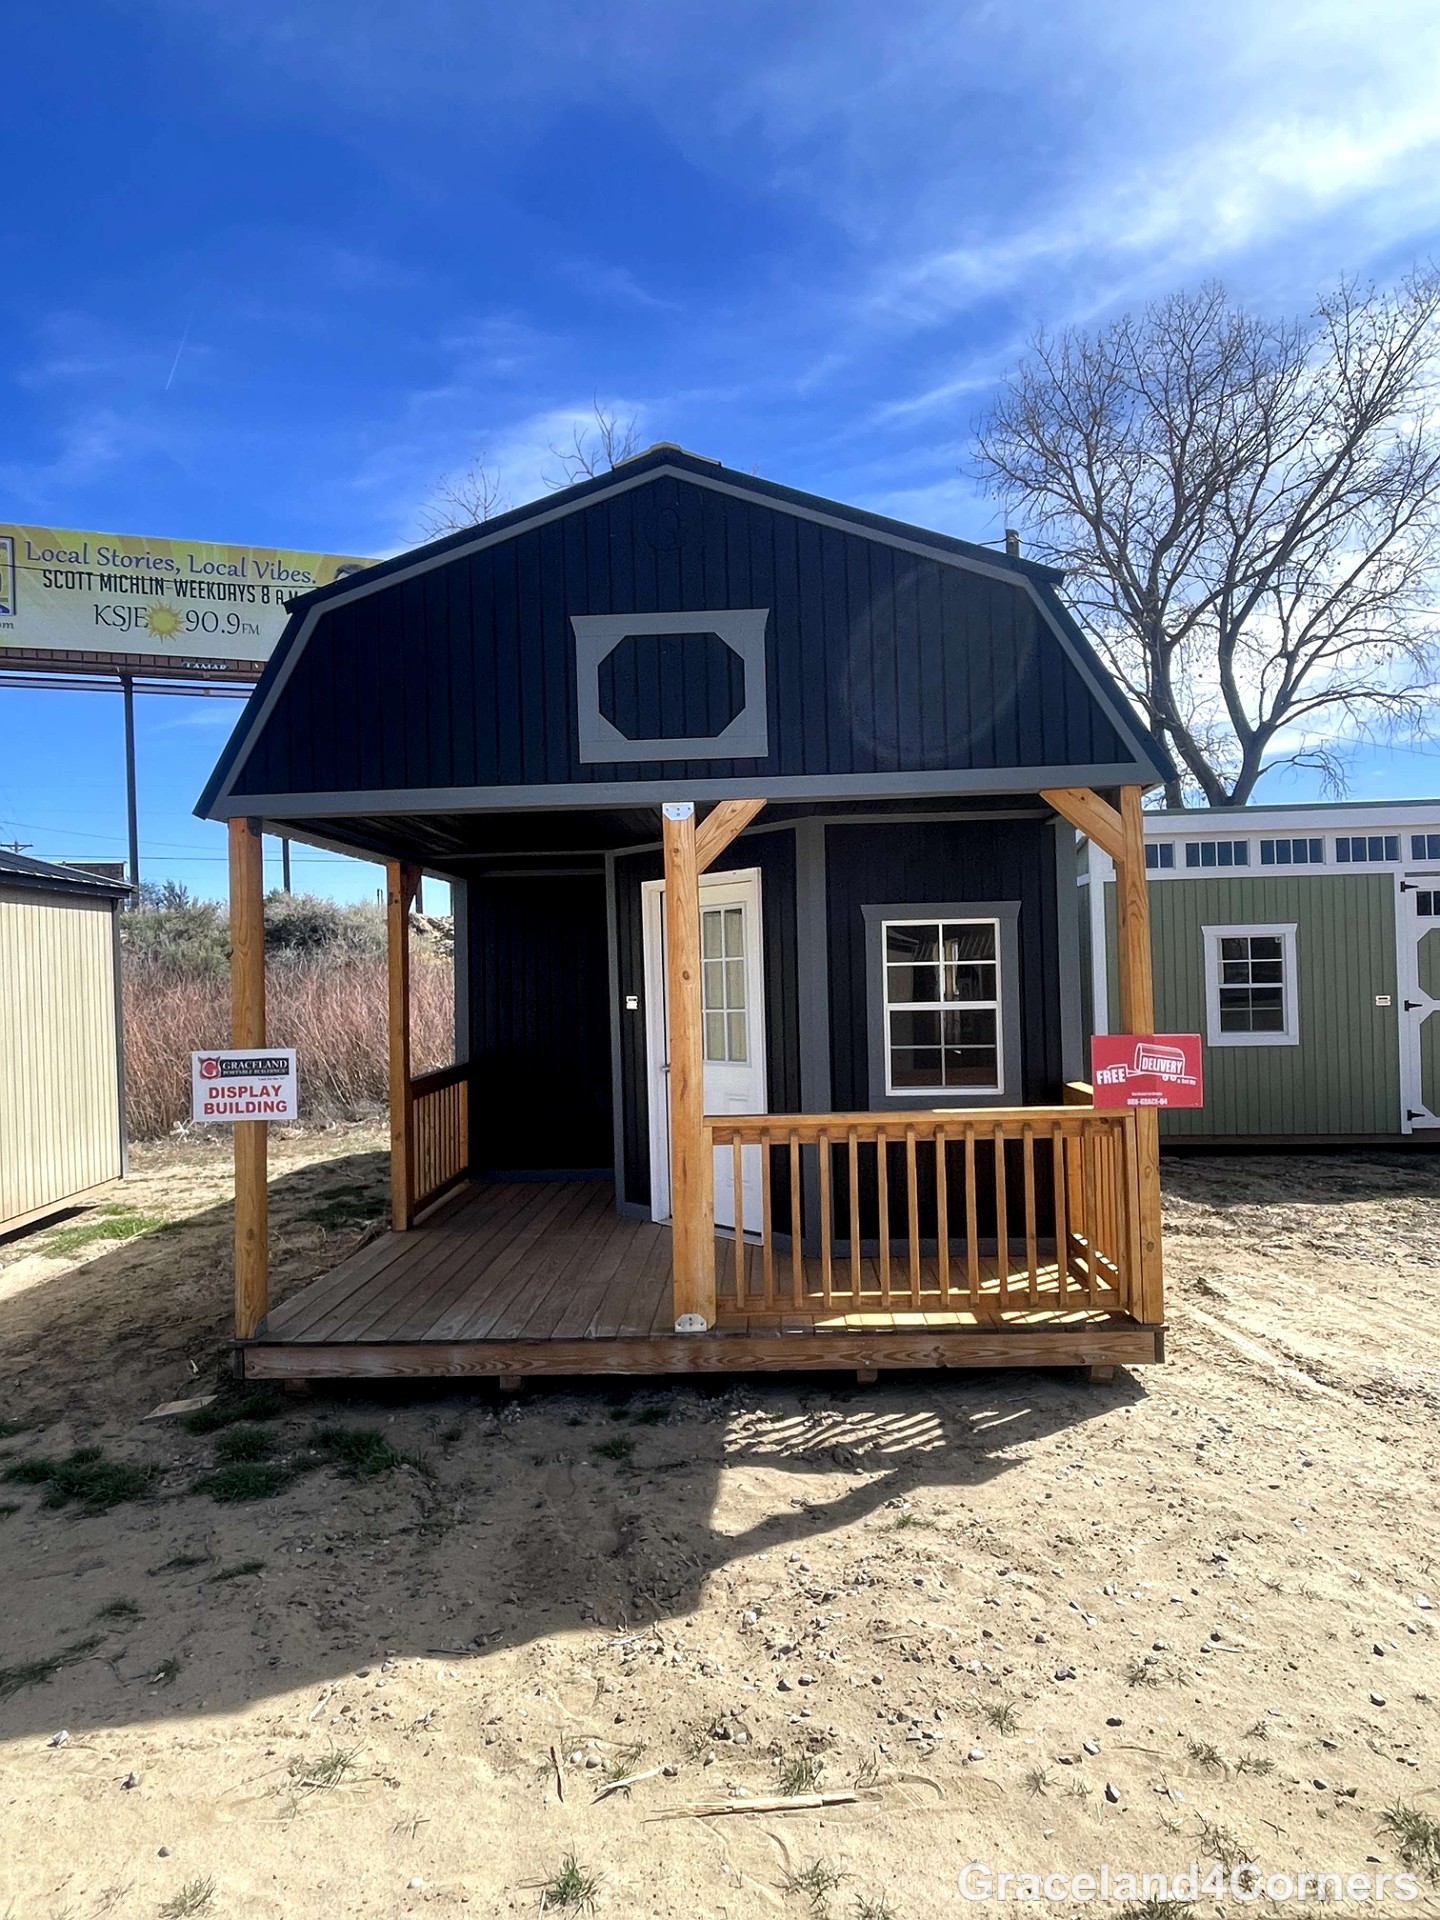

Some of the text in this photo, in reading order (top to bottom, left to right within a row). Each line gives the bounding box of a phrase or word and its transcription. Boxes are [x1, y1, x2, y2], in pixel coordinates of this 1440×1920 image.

[25, 540, 317, 584] Local Stories, Local Vibes.
[43, 569, 93, 591] SCOTT
[261, 585, 270, 604] 8
[94, 604, 149, 632] KSJE
[222, 1060, 287, 1070] GRACELAND
[1096, 1056, 1183, 1085] FREE DELIVERY
[208, 1084, 282, 1099] DISPLAY
[204, 1100, 287, 1115] BUILDING
